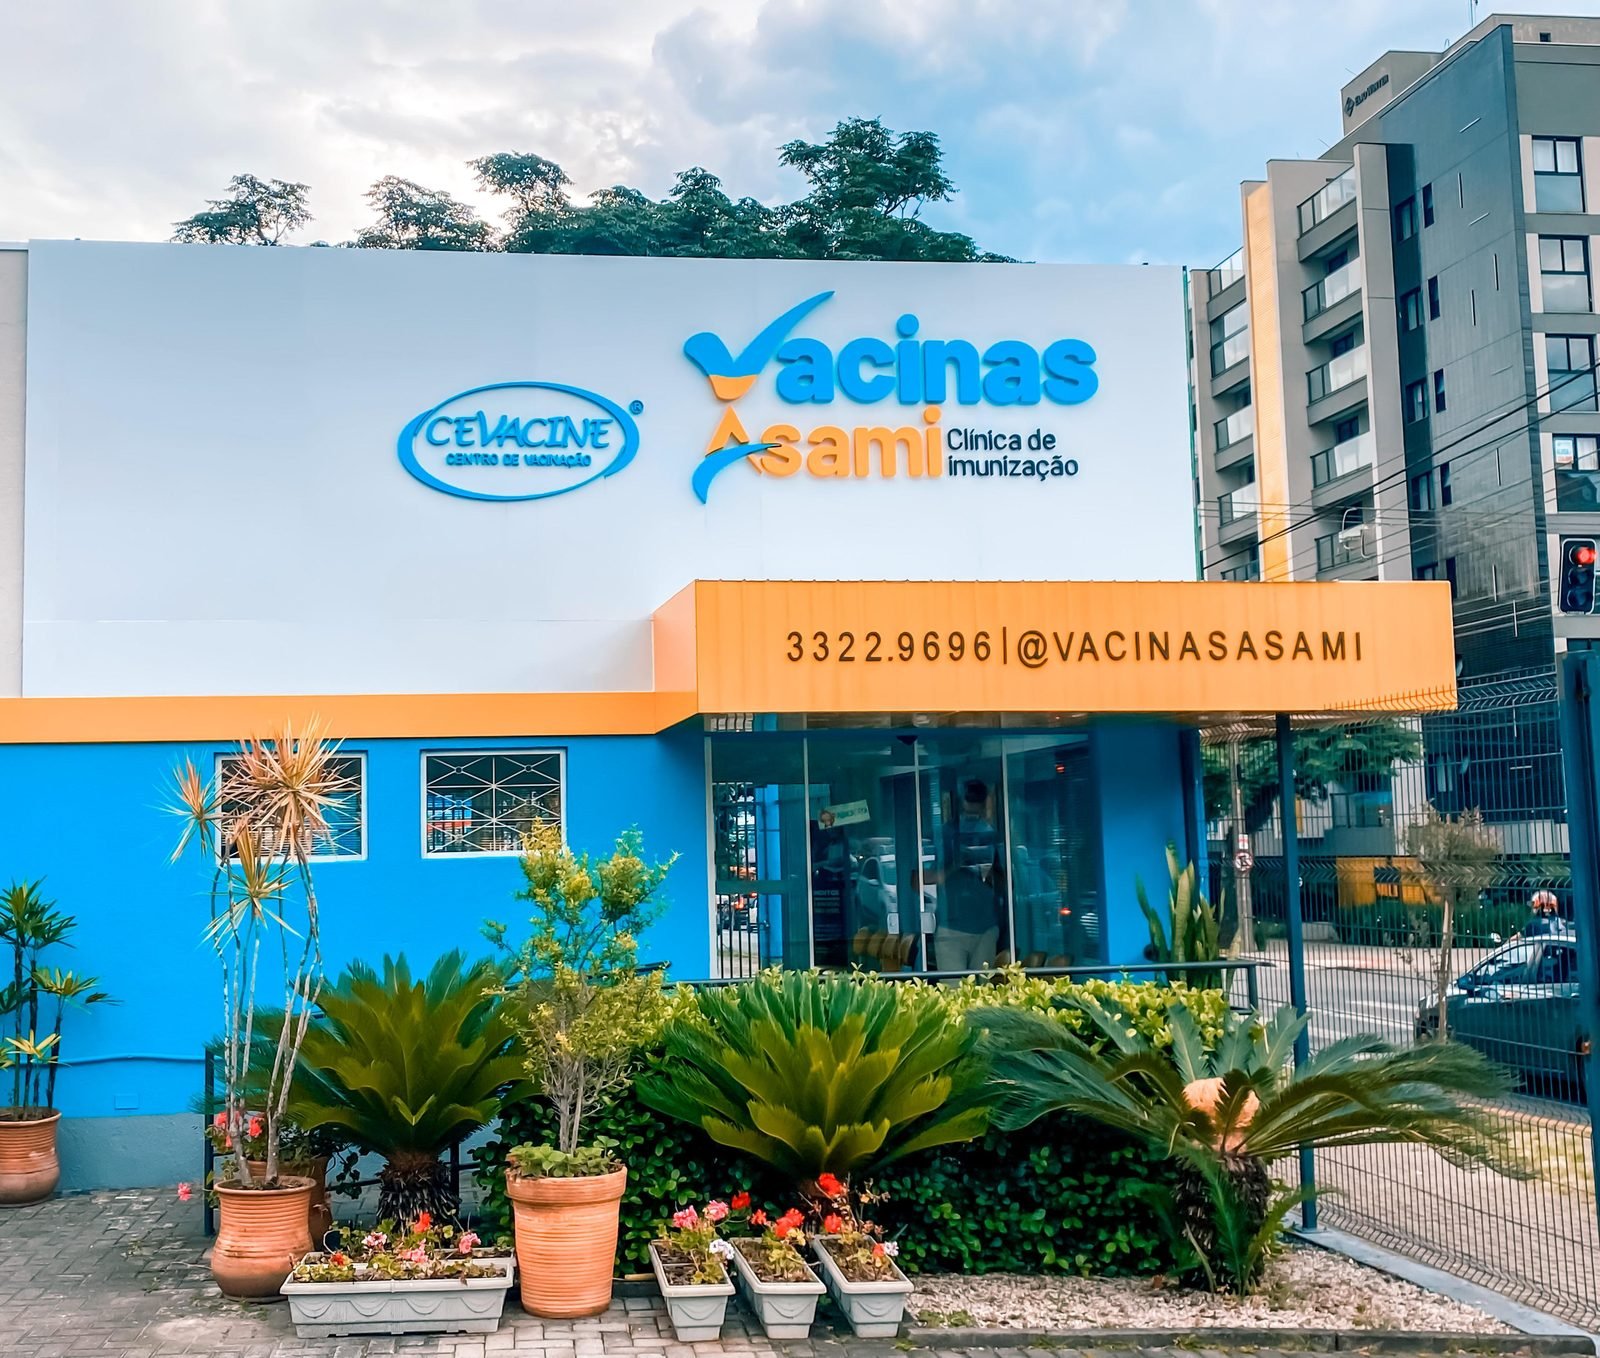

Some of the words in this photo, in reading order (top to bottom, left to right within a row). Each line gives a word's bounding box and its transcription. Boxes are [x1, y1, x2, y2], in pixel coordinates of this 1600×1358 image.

[682, 289, 1100, 405] Vacinas
[426, 410, 613, 449] CEVACINE
[704, 404, 943, 479] Asami
[946, 428, 1022, 452] Clínica
[1027, 428, 1057, 452] de
[446, 452, 499, 467] CENTRO
[503, 453, 520, 467] DE
[524, 452, 592, 468] VACINAÇÃO
[947, 454, 1080, 482] imunização
